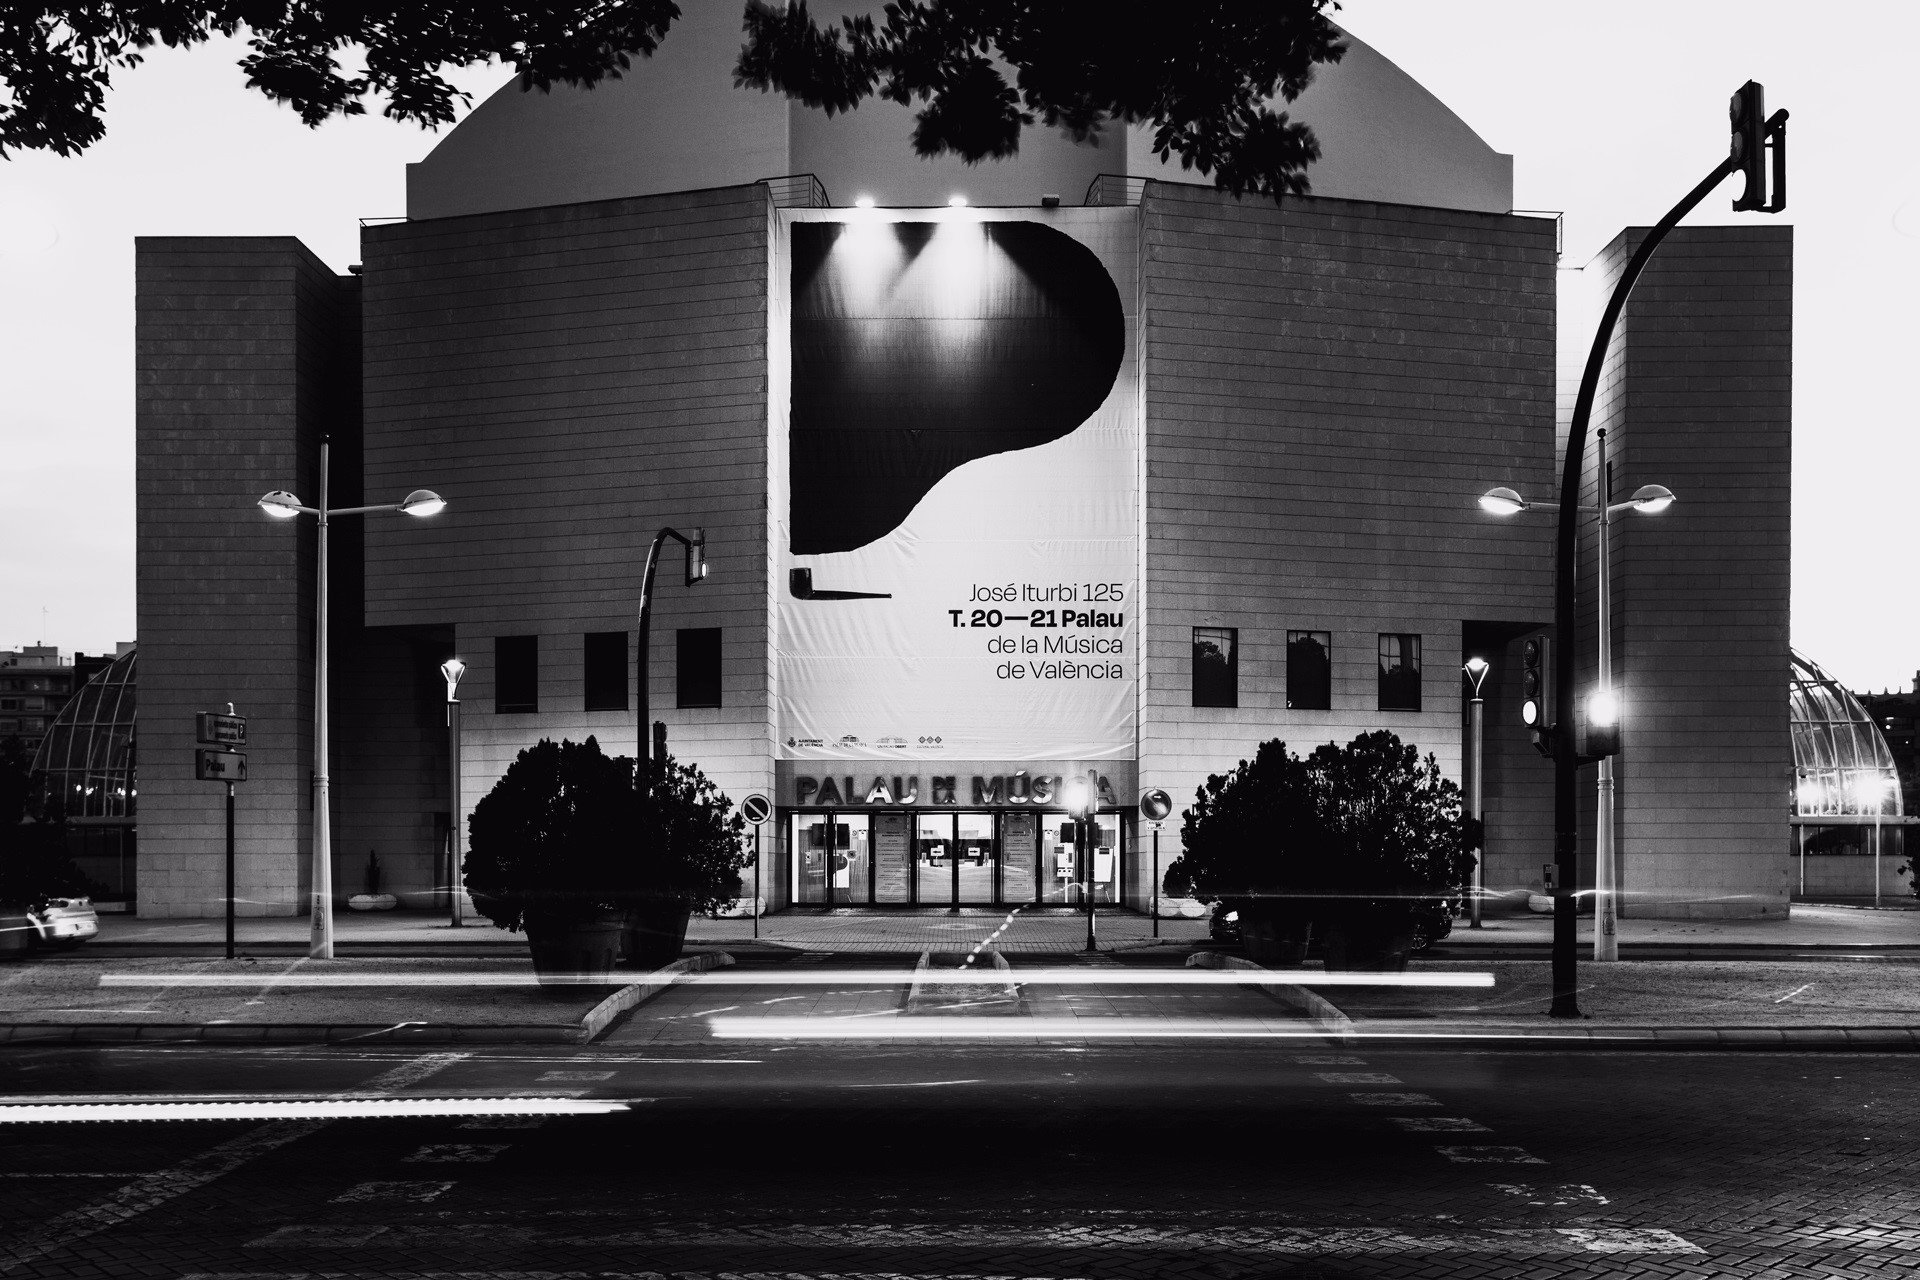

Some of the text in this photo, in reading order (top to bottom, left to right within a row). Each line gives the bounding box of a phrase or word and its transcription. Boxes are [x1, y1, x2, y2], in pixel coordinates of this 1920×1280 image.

[969, 582, 1124, 602] José Iturbi 125
[948, 609, 966, 628] T.
[1062, 609, 1124, 628] Palau
[987, 634, 1123, 654] de la Música
[996, 659, 1123, 679] de València
[206, 759, 225, 772] Palau
[796, 776, 918, 804] PALAU
[971, 770, 1117, 804] MÚSIA
